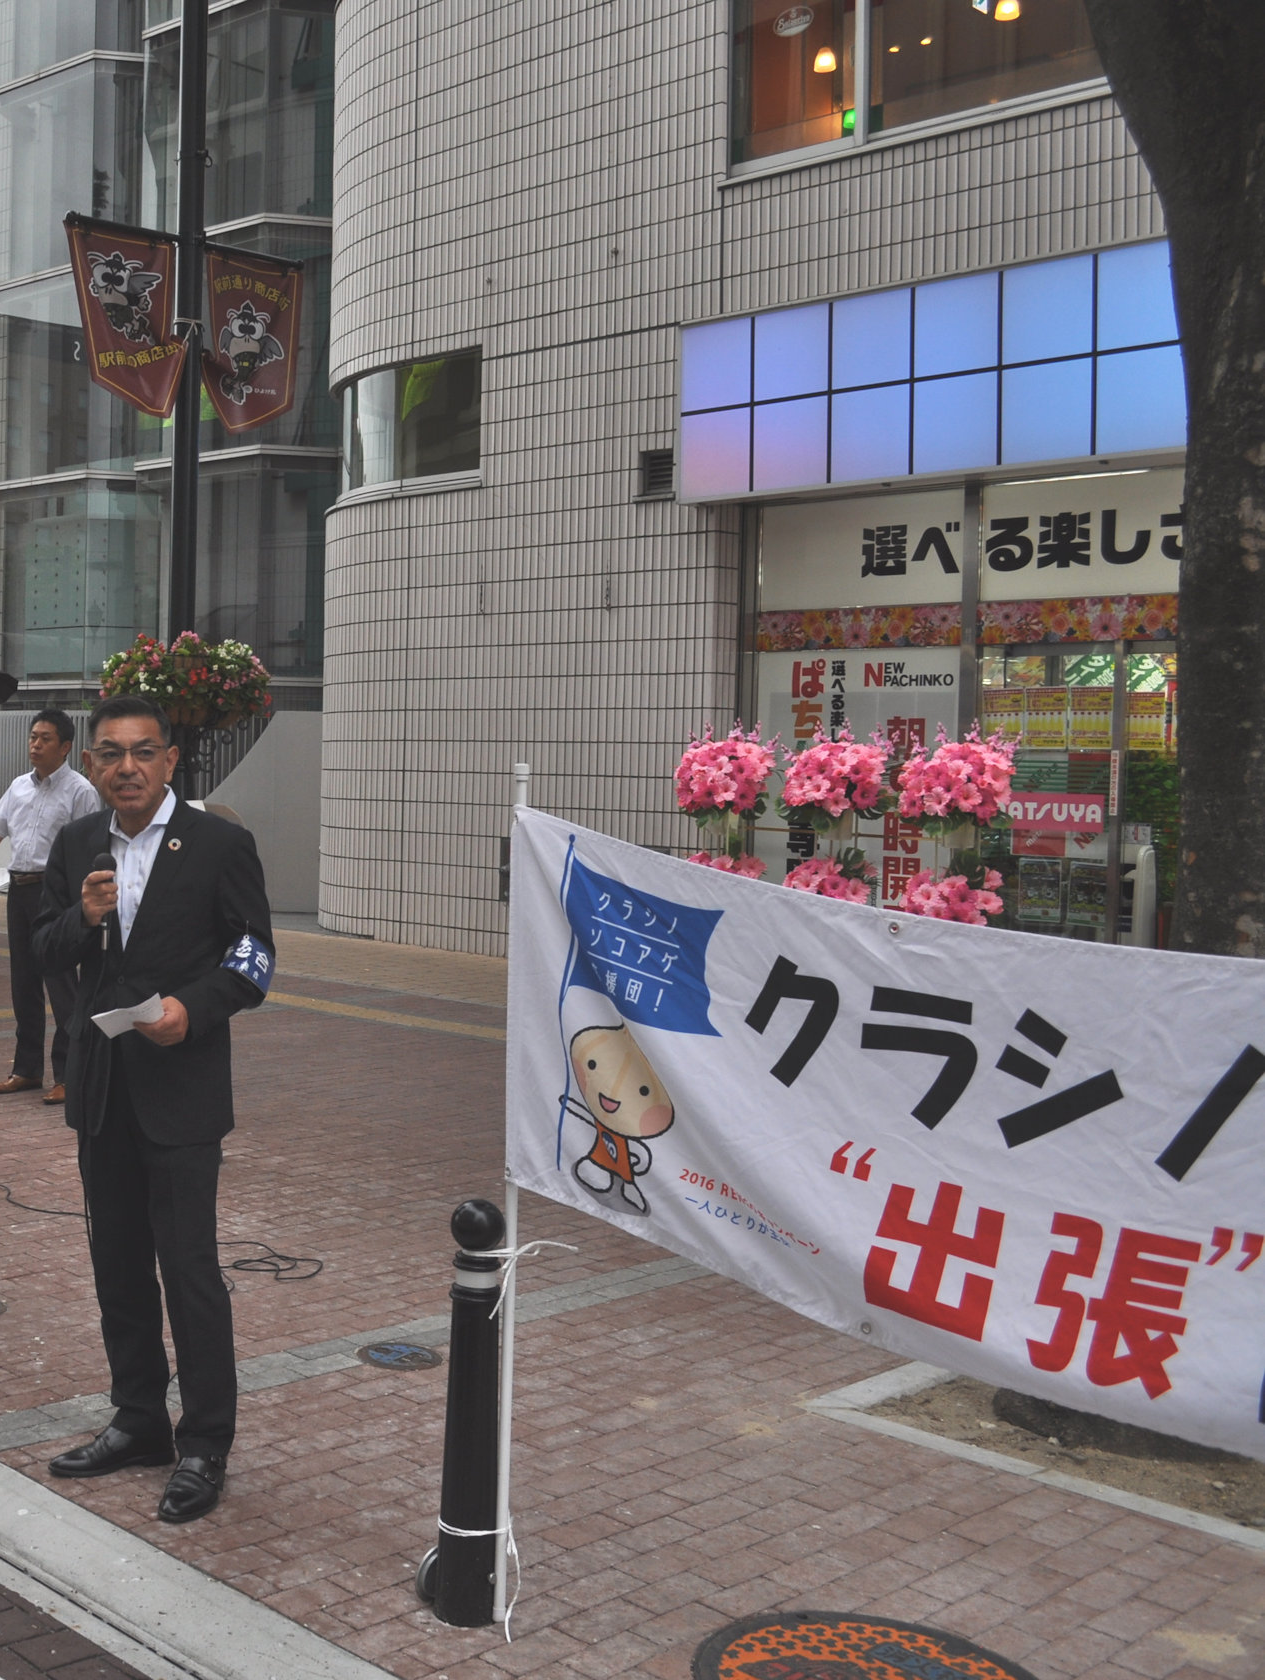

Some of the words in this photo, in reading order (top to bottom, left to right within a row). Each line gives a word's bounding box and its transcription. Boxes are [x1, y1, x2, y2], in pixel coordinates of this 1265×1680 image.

[863, 662, 906, 688] NEW
[884, 673, 954, 687] PACHINKO
[598, 891, 678, 935] クラシノ
[590, 929, 679, 973] ソコアゲ
[591, 962, 664, 1013] 援団！
[743, 954, 1265, 1183] クラシノ
[678, 1168, 715, 1191] 2016
